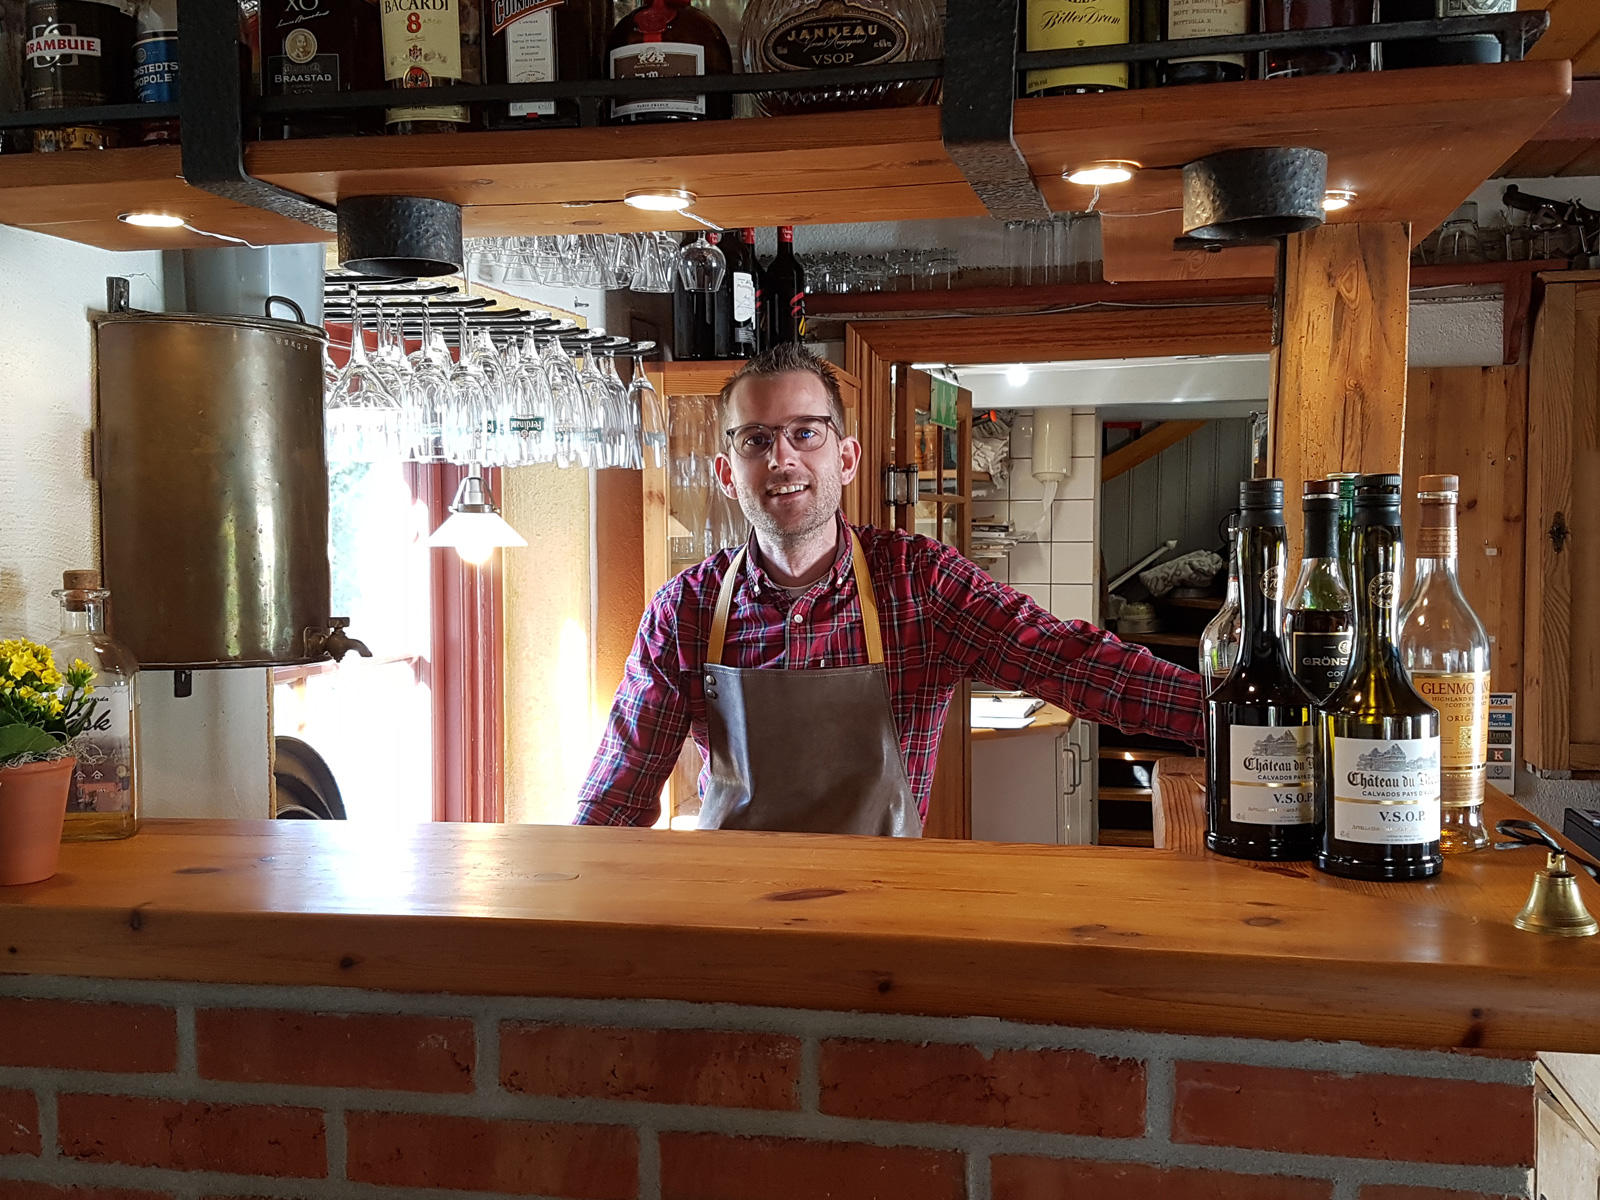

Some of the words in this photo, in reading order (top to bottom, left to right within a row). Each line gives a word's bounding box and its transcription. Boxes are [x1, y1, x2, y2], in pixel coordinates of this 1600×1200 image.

[385, 0, 448, 14] BACARDI
[407, 12, 421, 33] 8
[787, 25, 878, 41] JANNEAU
[26, 39, 96, 56] DRAMBUIE
[812, 53, 854, 65] VSOP
[274, 74, 332, 83] BRAASTAD
[1302, 656, 1349, 666] GRÖNS
[1494, 750, 1504, 761] K
[1243, 756, 1292, 773] Château
[1293, 760, 1305, 772] du
[1347, 771, 1400, 789] Château
[1401, 776, 1415, 788] du
[1273, 792, 1313, 803] V.S.O.P.
[1362, 790, 1401, 798] CALVADOS
[1379, 810, 1426, 822] V.S.O.P.
